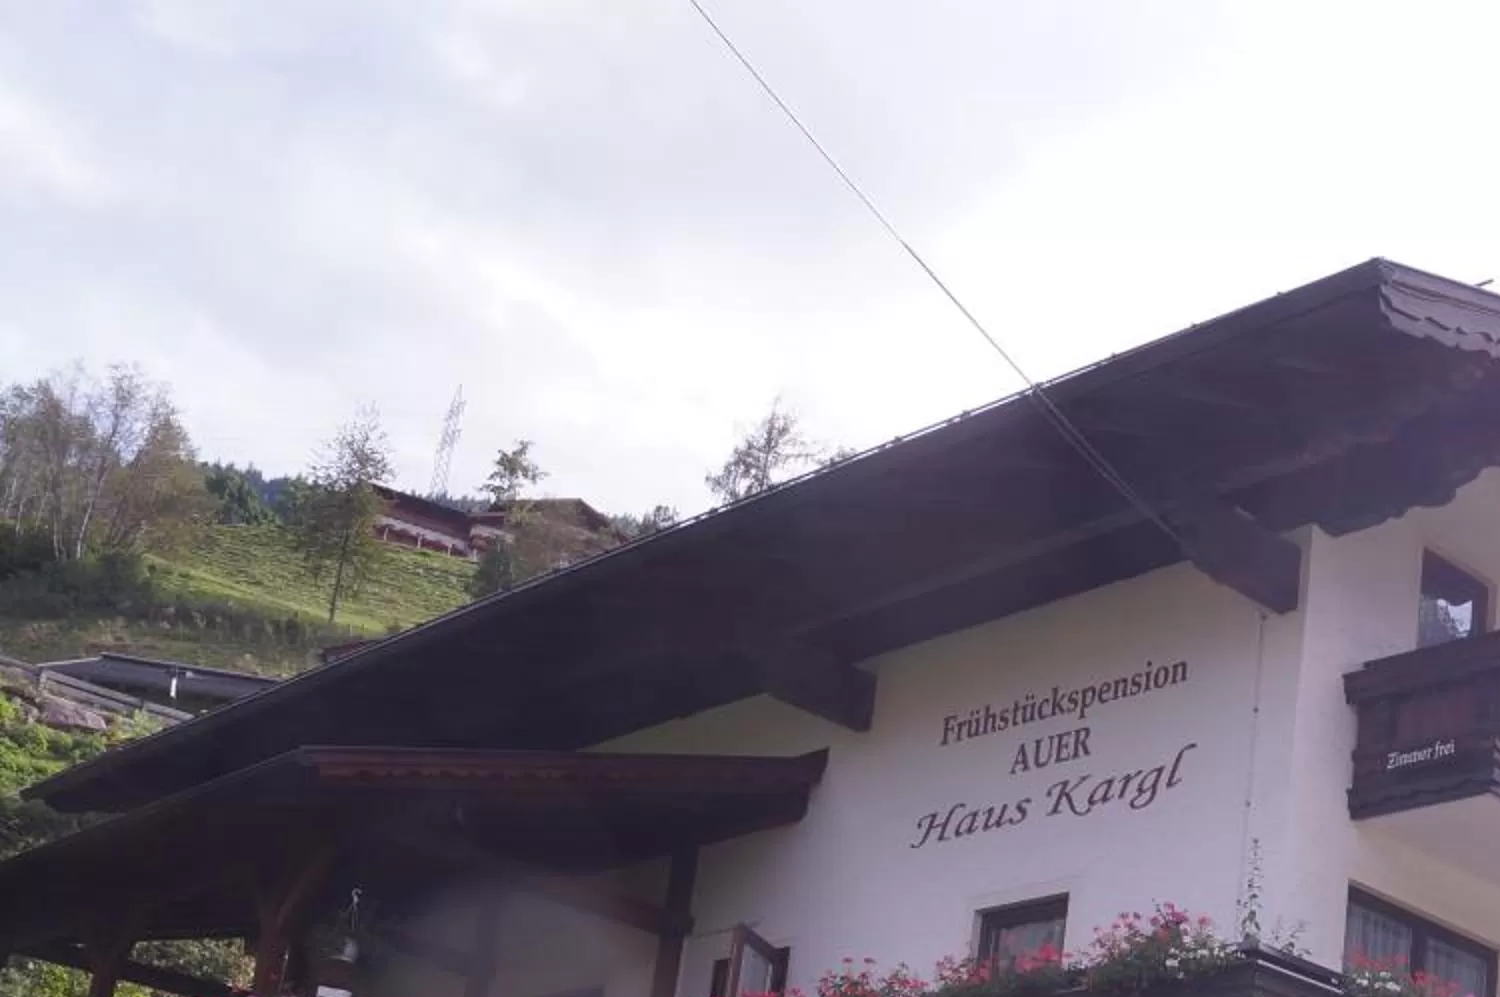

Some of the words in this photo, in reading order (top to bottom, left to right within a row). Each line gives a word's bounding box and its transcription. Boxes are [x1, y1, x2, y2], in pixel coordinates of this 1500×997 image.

[940, 660, 1188, 746] Frühstückspension
[1010, 726, 1092, 775] AUER
[910, 796, 1031, 849] Haus
[1046, 743, 1197, 817] Kargl
